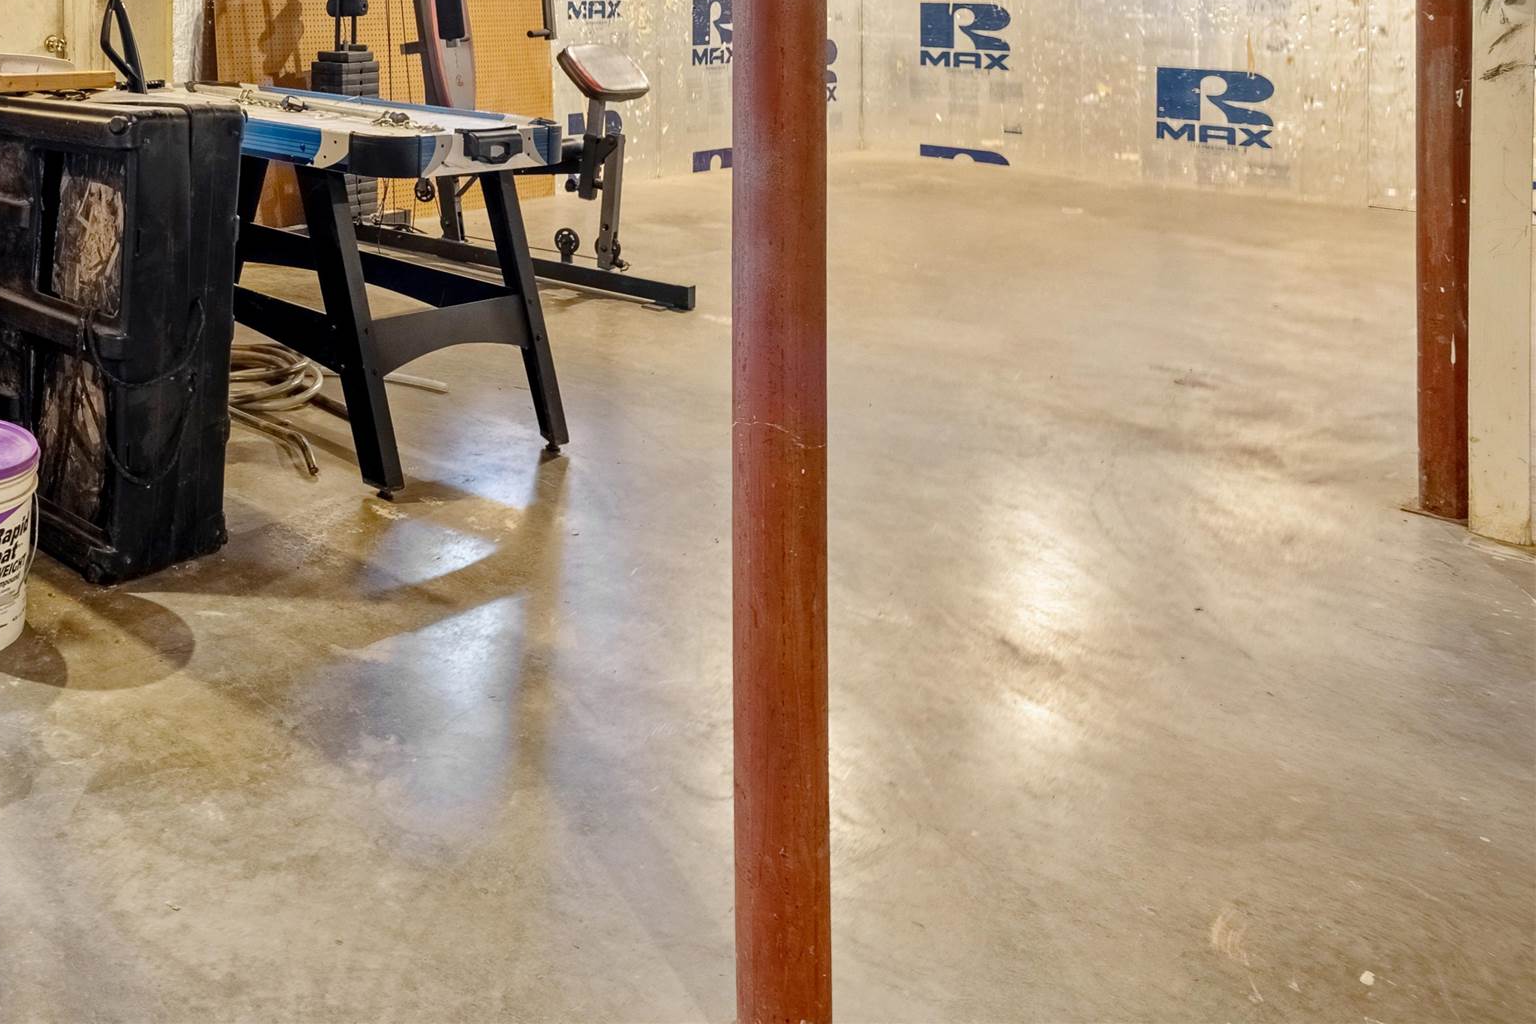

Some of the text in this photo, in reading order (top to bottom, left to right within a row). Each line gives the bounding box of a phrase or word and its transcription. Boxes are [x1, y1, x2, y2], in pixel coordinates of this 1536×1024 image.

[567, 0, 621, 20] MAX
[920, 2, 1011, 51] R
[920, 50, 1010, 71] MAX
[1157, 67, 1274, 127] R
[1156, 121, 1272, 149] MAX
